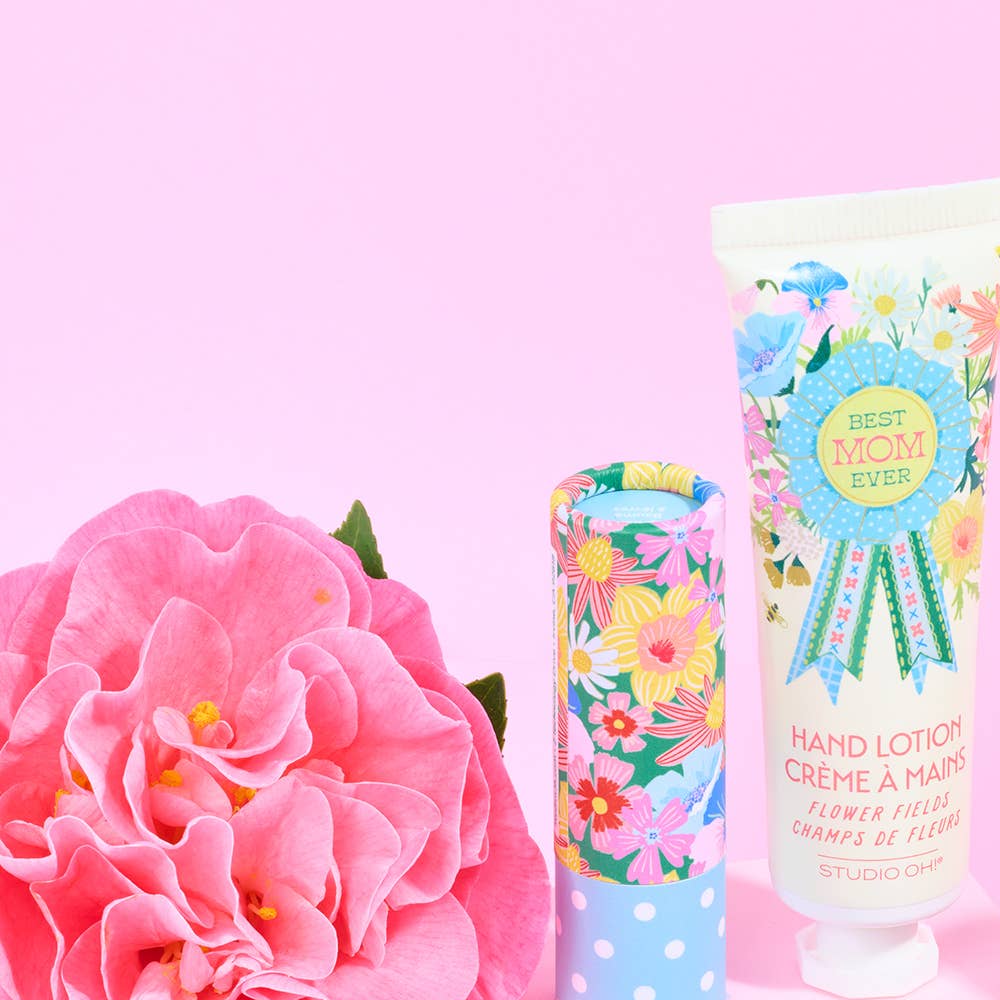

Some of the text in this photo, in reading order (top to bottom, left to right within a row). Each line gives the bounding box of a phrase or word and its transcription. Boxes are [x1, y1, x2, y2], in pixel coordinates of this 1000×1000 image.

[848, 409, 907, 431] BEST
[831, 430, 927, 466] MOM
[850, 467, 912, 489] EVER
[791, 714, 963, 759] HAND LOTION
[784, 745, 967, 794] CRÈME À MAINS
[807, 791, 951, 823] FLOWER FIELDS
[792, 808, 961, 847] CHAMPS DE FLEURS
[818, 863, 901, 882] STUDIO
